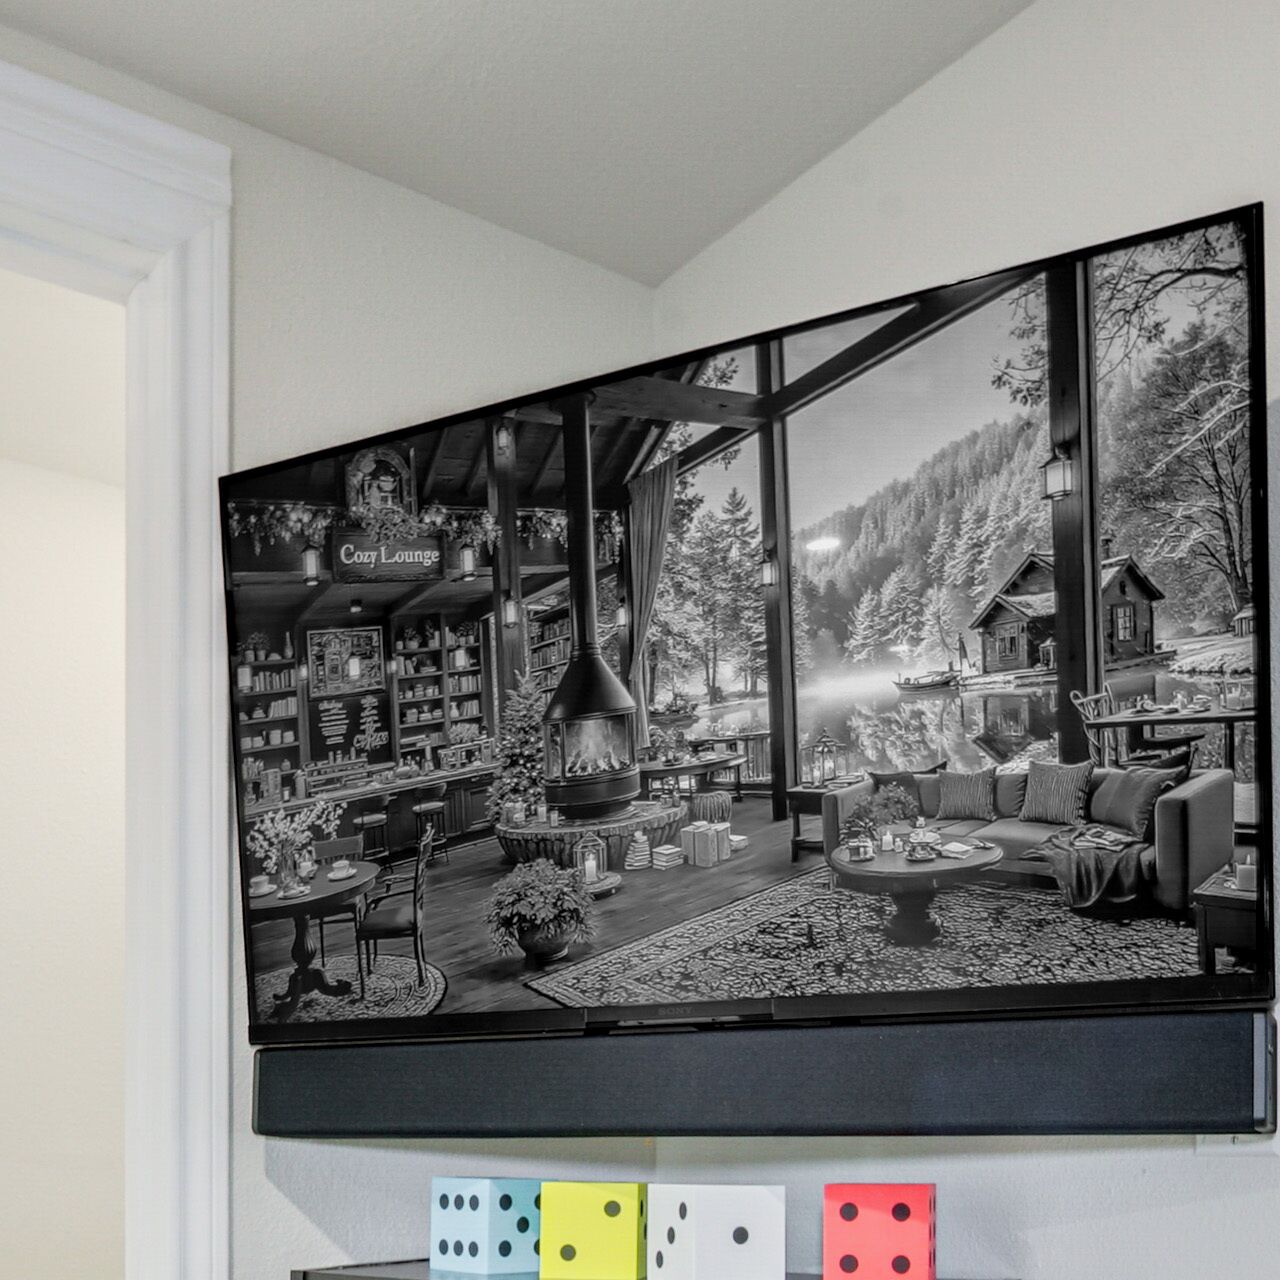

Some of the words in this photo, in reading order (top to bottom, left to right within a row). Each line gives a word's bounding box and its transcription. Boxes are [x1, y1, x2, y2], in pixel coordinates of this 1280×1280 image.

[340, 543, 378, 569] Cozy
[380, 545, 441, 570] Lounge
[657, 1006, 693, 1016] SONY
